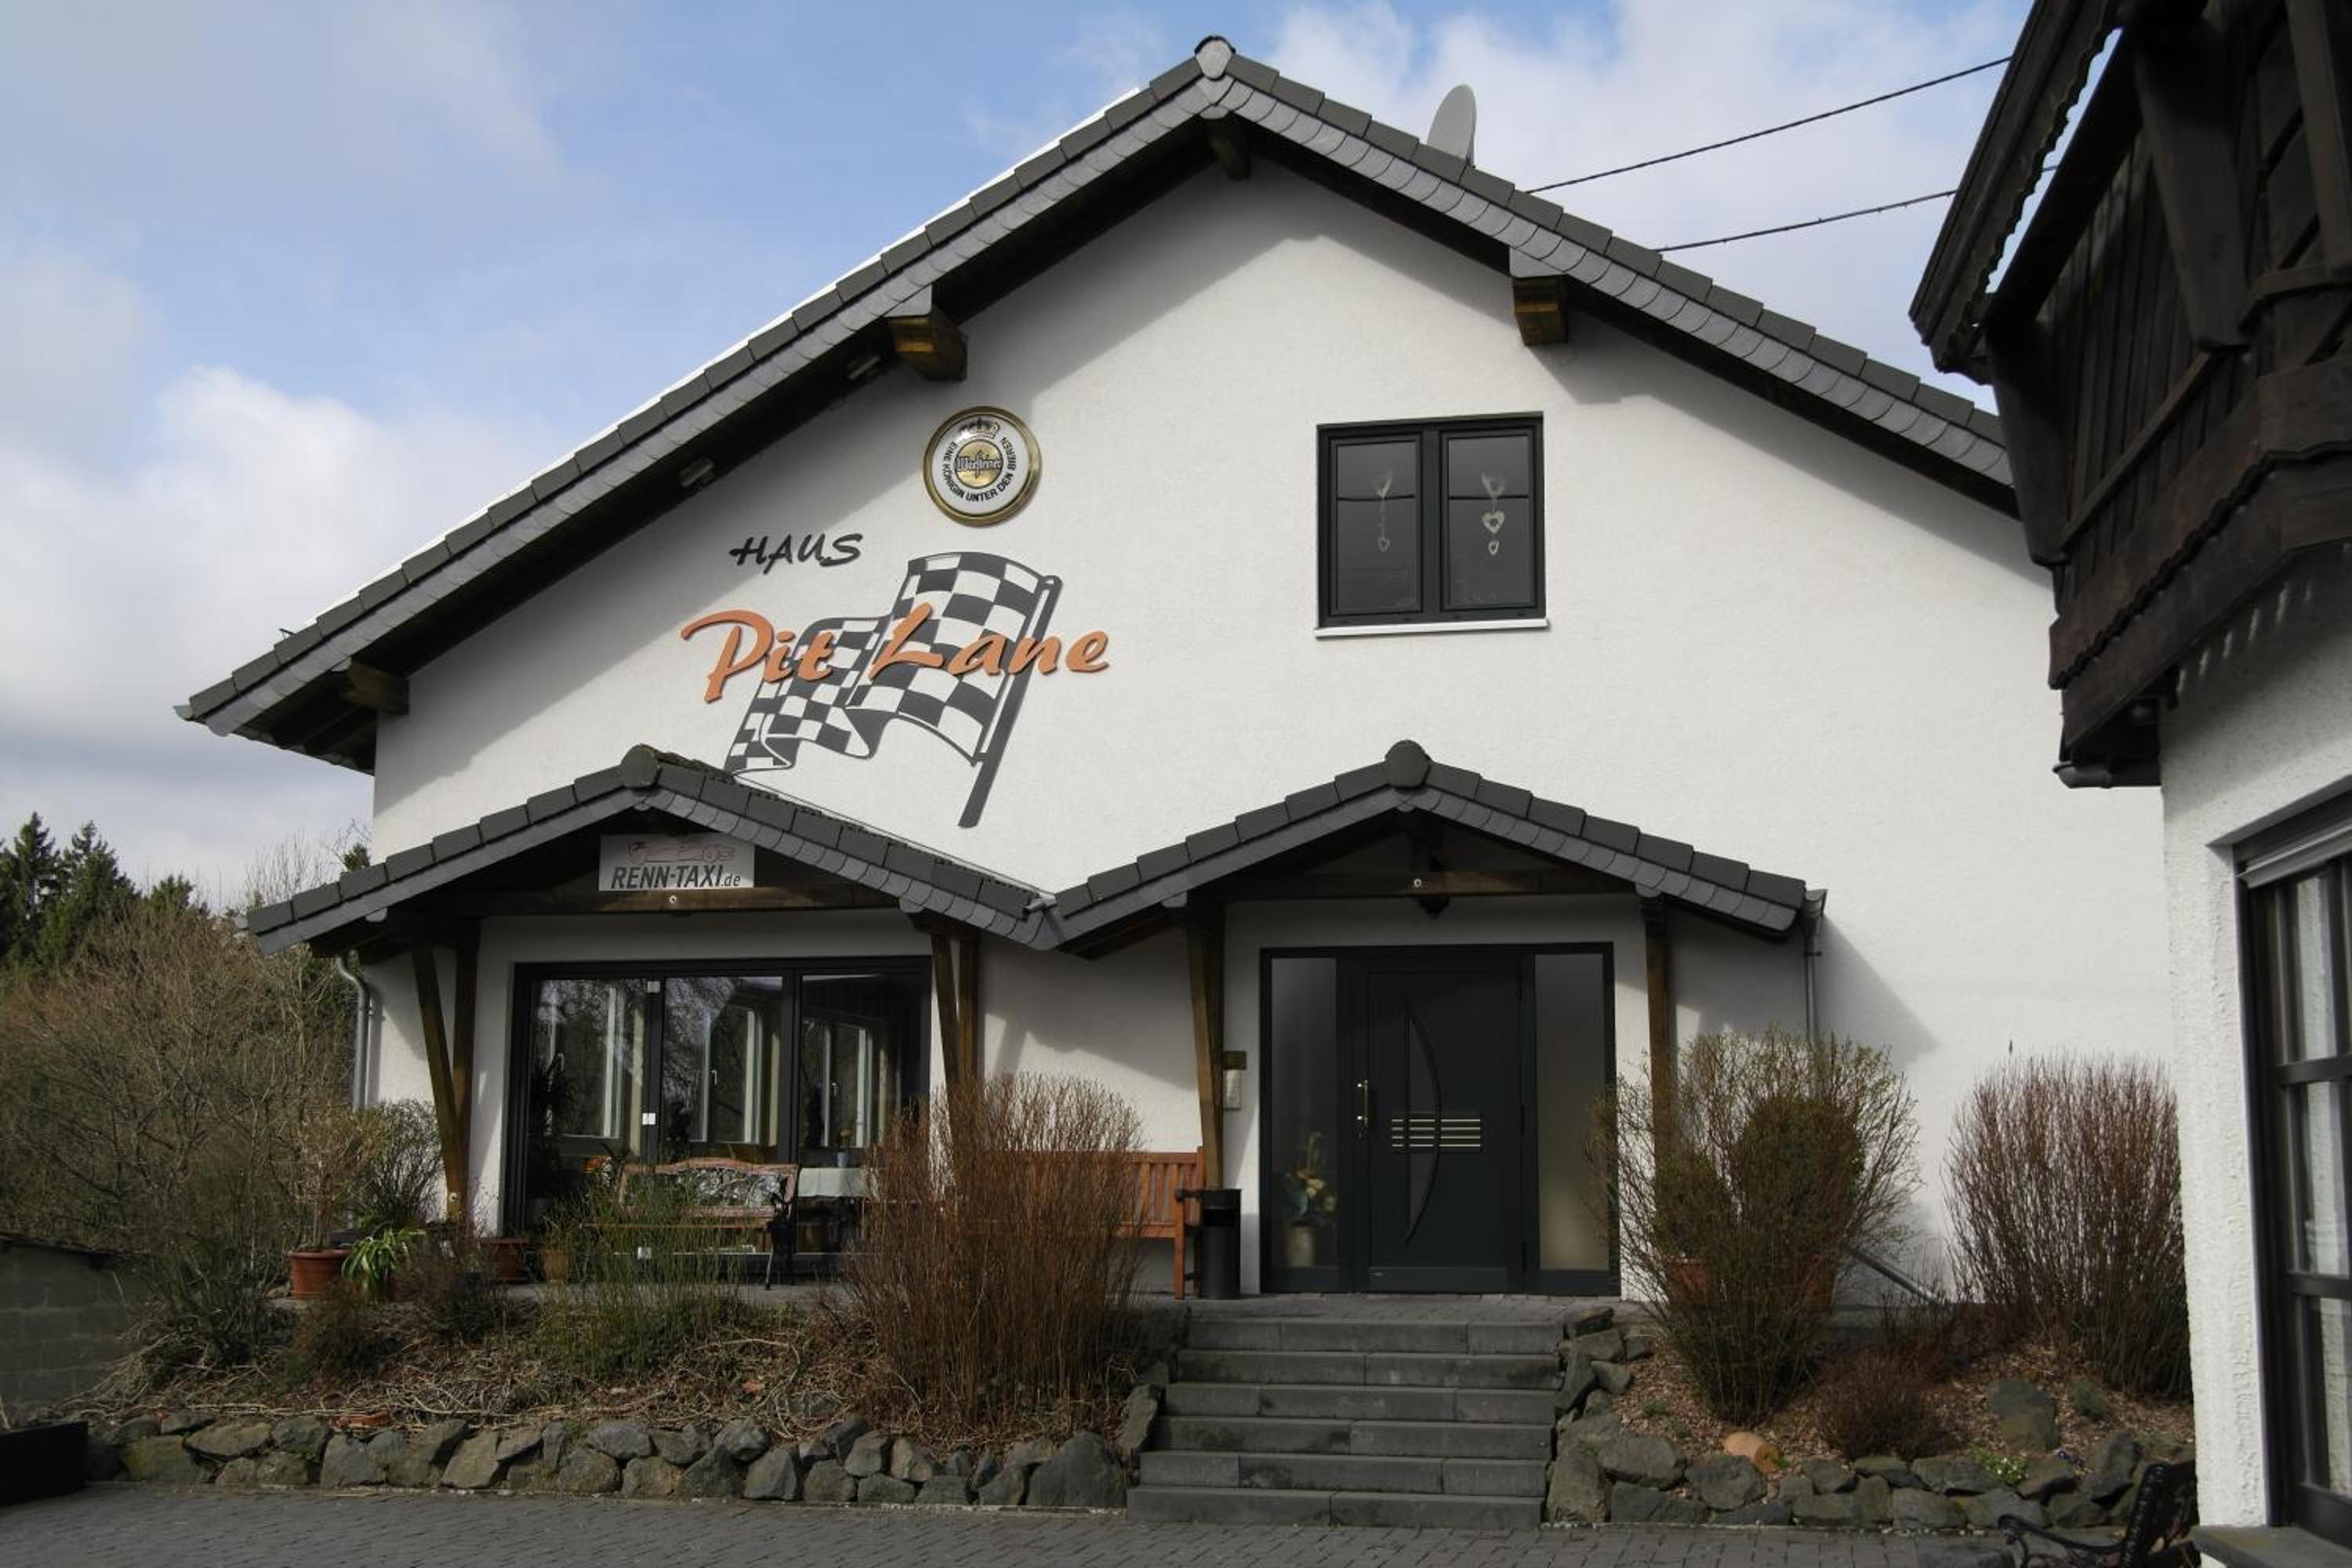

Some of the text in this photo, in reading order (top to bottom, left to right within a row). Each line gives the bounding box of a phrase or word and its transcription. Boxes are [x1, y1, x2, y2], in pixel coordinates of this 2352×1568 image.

[943, 441, 958, 461] EINE
[1000, 437, 1017, 471] BIEREN
[997, 472, 1014, 492] DEN
[966, 488, 998, 502] UNTER
[728, 533, 864, 575] HAUS
[681, 602, 1111, 703] Pit Lane
[611, 864, 741, 888] RENN-TAXI.de
